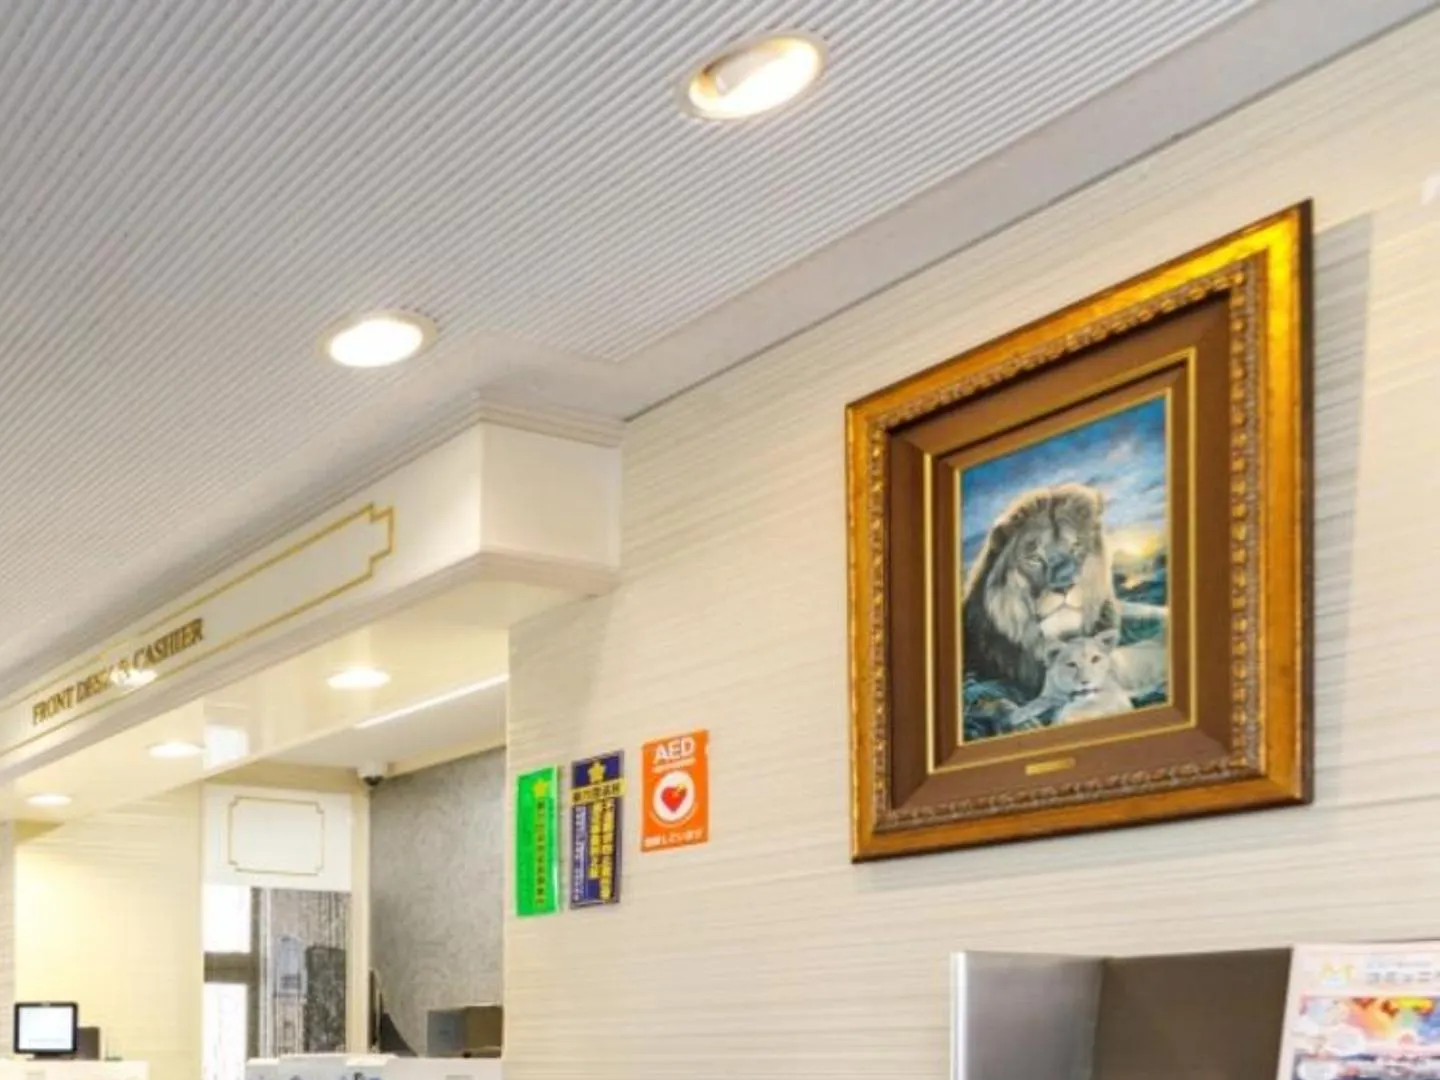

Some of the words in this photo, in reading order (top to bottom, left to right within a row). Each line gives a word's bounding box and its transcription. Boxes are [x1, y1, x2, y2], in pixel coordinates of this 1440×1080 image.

[32, 684, 76, 726] FRONT
[133, 617, 205, 669] CASHIER
[653, 737, 697, 764] AED
